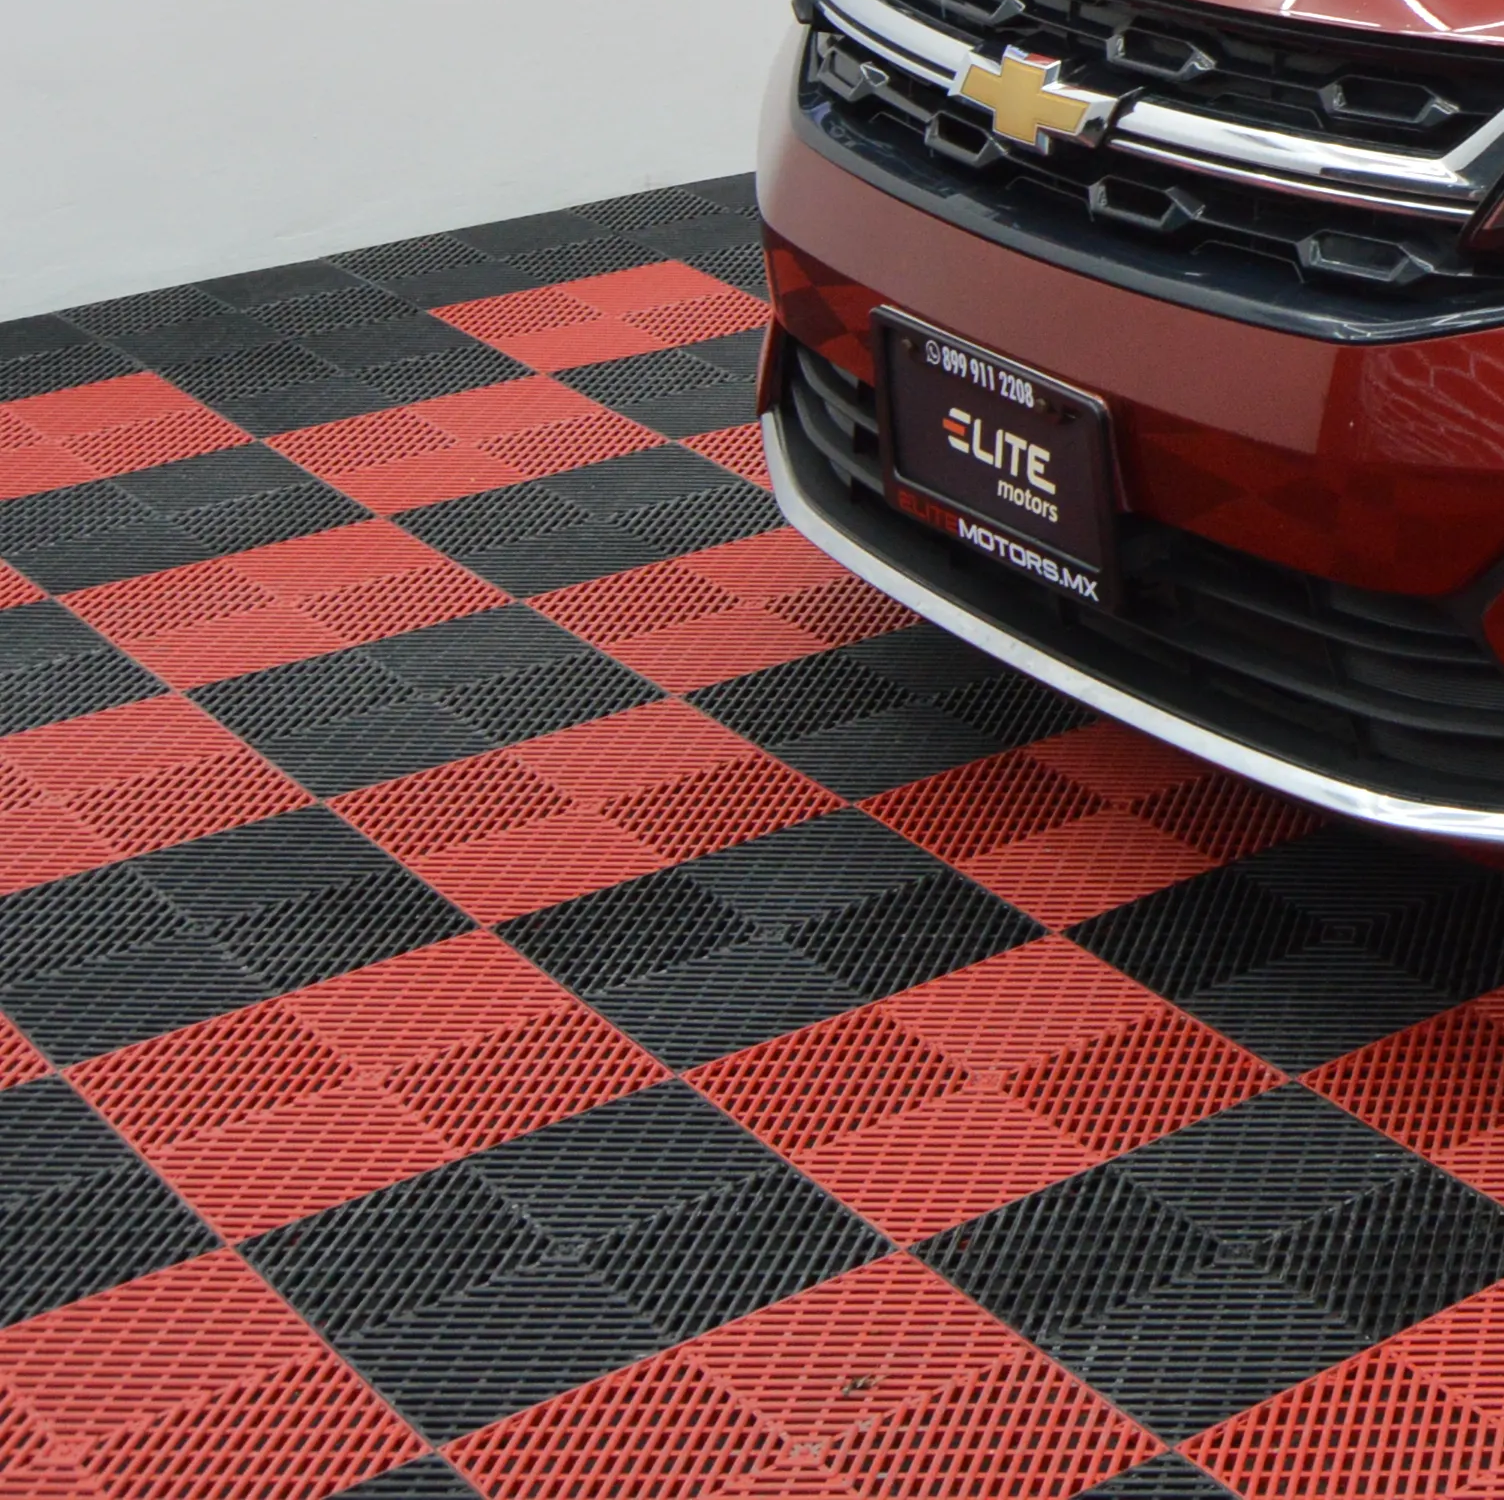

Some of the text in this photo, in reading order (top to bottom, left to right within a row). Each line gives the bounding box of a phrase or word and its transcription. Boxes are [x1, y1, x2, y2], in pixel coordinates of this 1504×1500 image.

[941, 345, 1035, 409] 899 911 2208
[941, 406, 1057, 496] ELITE
[996, 478, 1060, 524] motors
